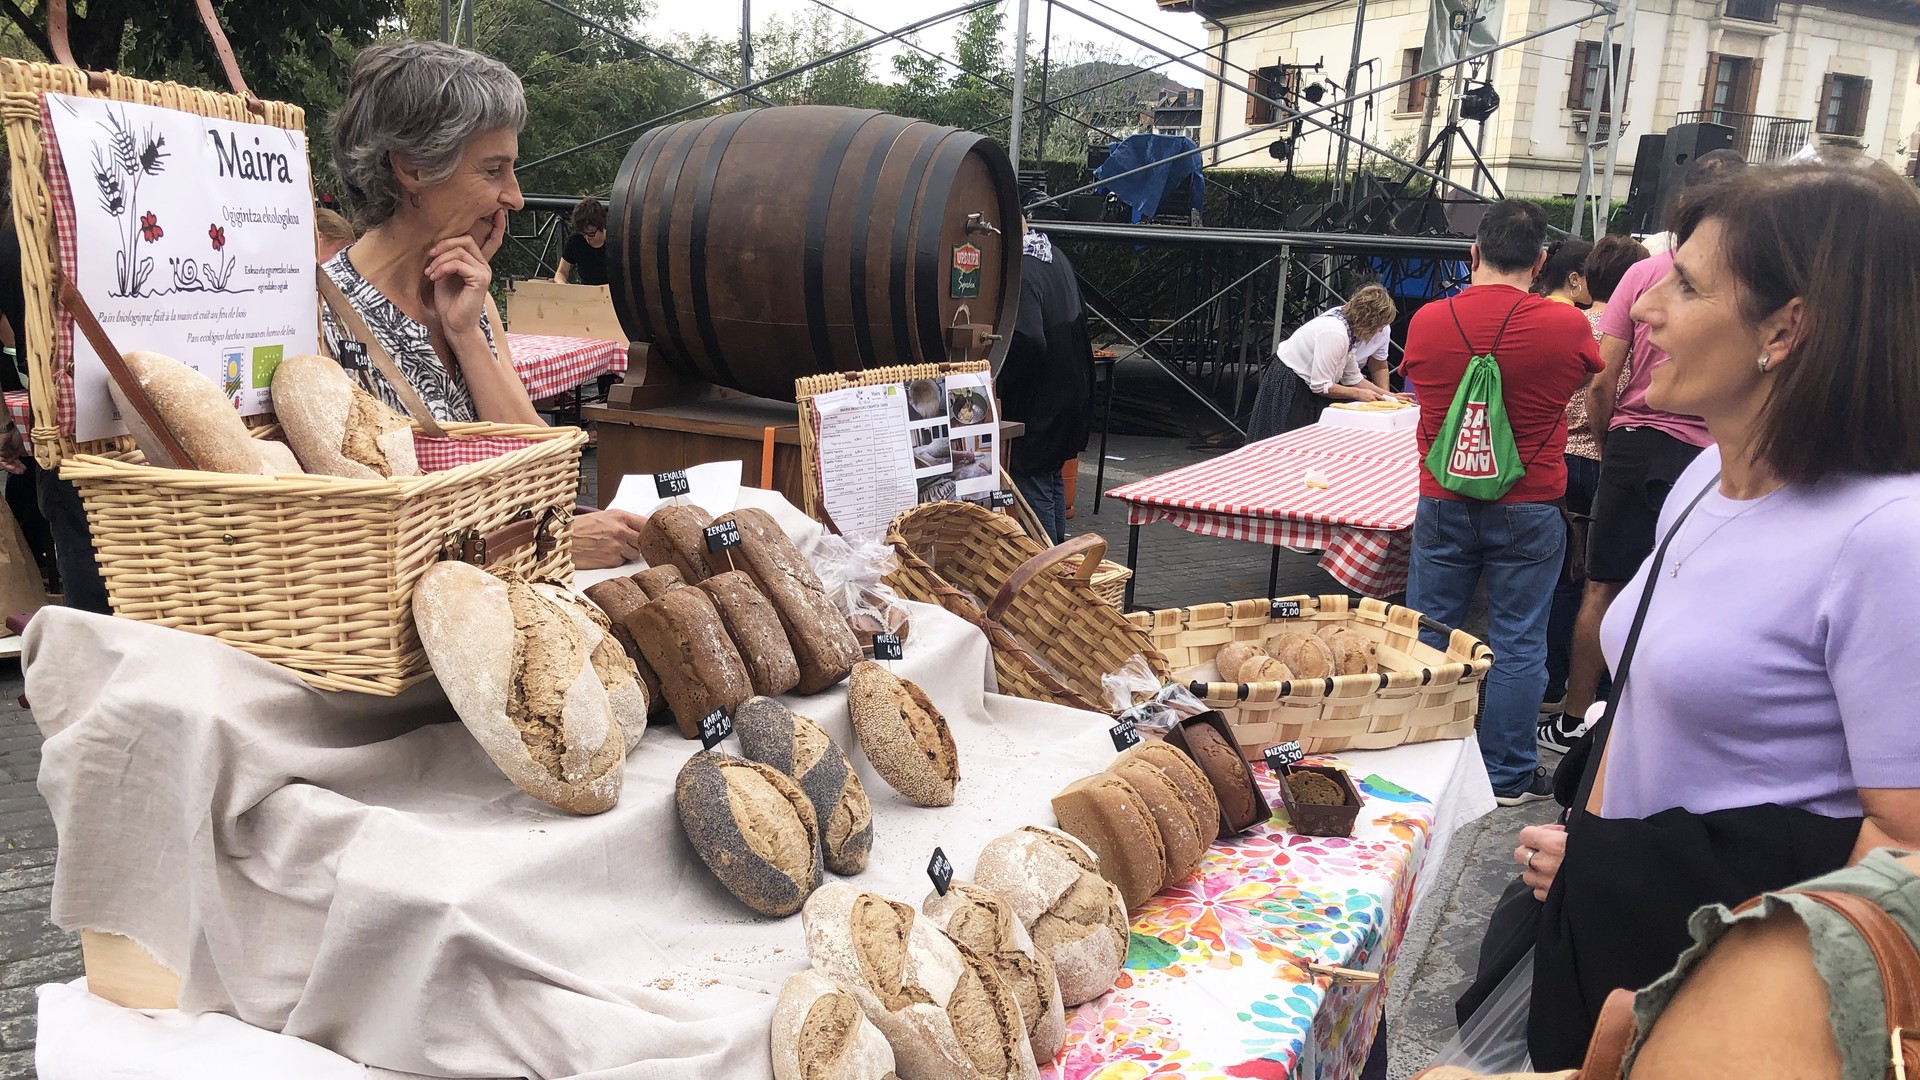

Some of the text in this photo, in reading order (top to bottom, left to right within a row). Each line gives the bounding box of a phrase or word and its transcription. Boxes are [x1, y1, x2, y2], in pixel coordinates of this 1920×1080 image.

[208, 129, 293, 184] Maira
[222, 205, 300, 230] Ogigintza ekologikoa
[97, 311, 115, 323] Pain
[116, 310, 153, 326] biologique
[150, 309, 165, 326] fait
[170, 309, 177, 322] la
[228, 306, 236, 319] de
[236, 306, 247, 319] bois
[187, 332, 199, 343] Pan
[200, 330, 224, 345] ecológico
[225, 328, 241, 341] hecho
[670, 479, 687, 493] 5,10
[706, 520, 736, 537] ZEKALEA
[721, 530, 740, 546] 3,00
[1281, 607, 1300, 617] 2,00
[877, 634, 900, 644] MUESLY
[887, 644, 901, 658] 4,10
[703, 709, 722, 730] GARIA
[716, 715, 731, 737] 2,80
[1264, 740, 1300, 758] BIZKOTXO
[1278, 749, 1303, 764] 3,90
